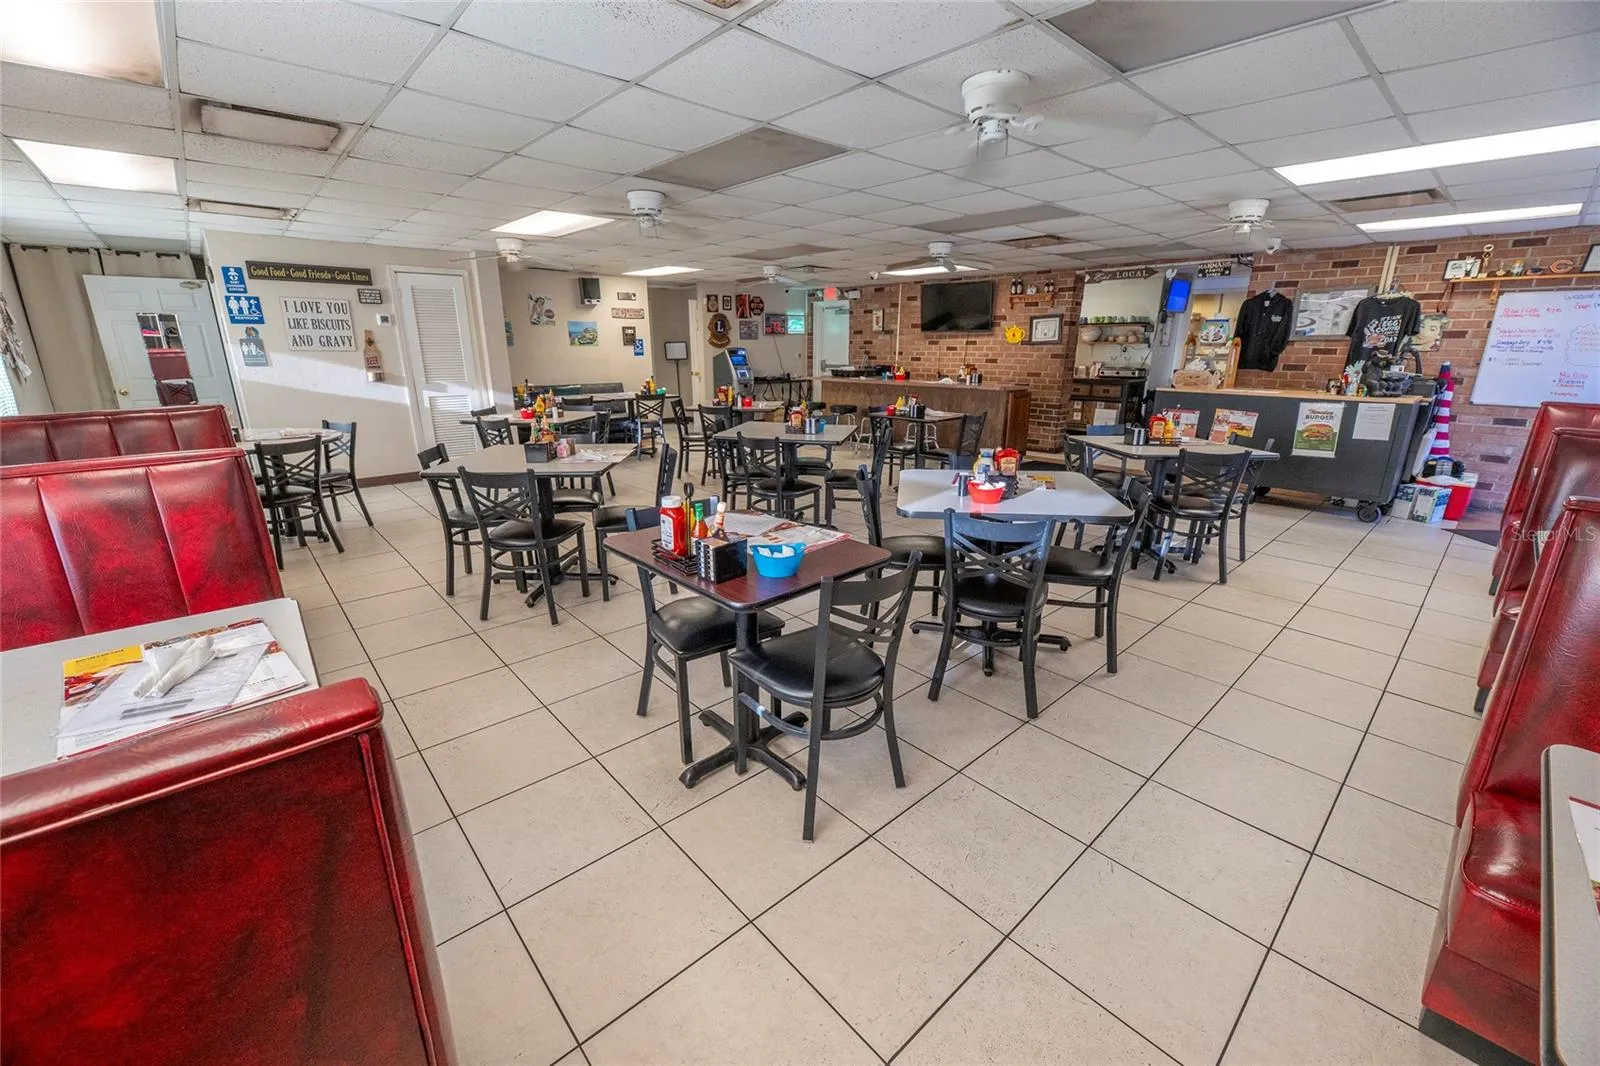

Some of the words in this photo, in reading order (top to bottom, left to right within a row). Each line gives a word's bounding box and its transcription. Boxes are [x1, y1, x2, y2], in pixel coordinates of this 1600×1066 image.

[250, 265, 269, 277] Good
[269, 266, 286, 278] Food
[289, 267, 307, 279] Good
[307, 269, 331, 281] Friends
[334, 270, 350, 281] Good
[350, 271, 369, 281] Times
[1116, 269, 1148, 279] LOCAL
[283, 300, 289, 312] I
[293, 300, 323, 314] LOVE
[326, 301, 348, 315] YOU
[287, 317, 309, 330] LIKE
[310, 318, 351, 331] BISCUITS
[292, 334, 314, 347] AND
[318, 334, 353, 348] GRAVY
